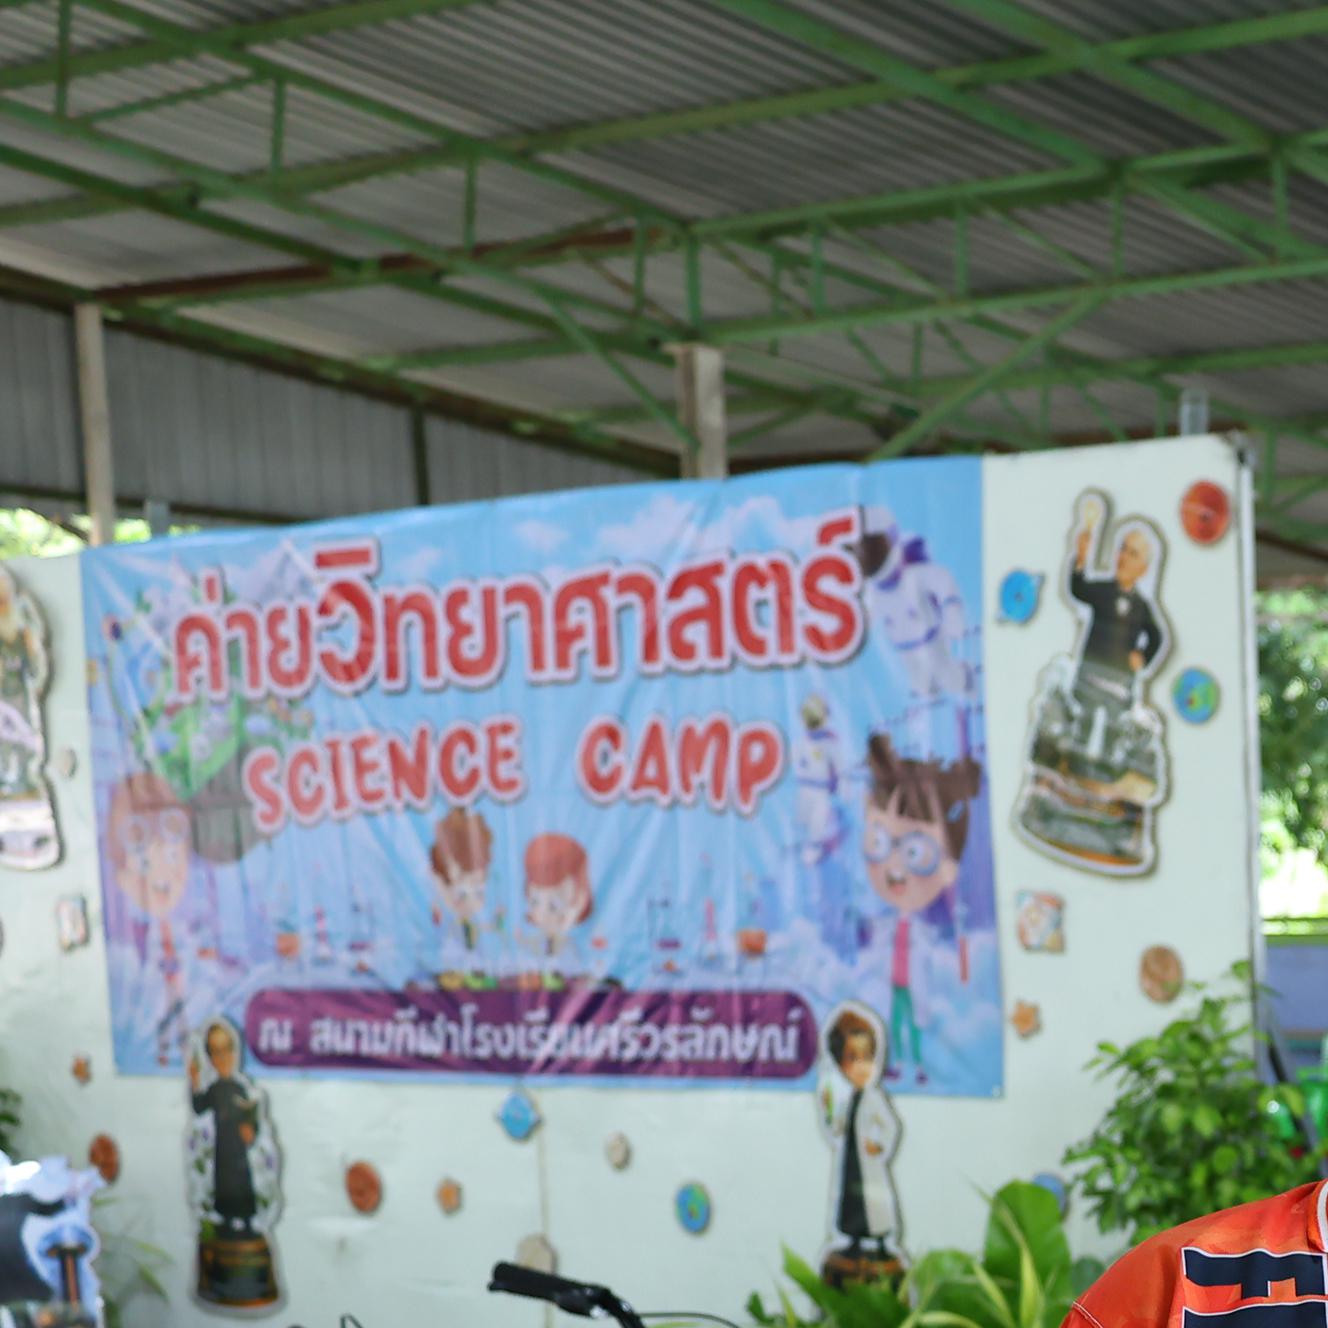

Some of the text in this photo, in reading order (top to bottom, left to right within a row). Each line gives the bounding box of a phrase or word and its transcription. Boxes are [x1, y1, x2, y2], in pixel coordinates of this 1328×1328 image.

[173, 512, 862, 696] ค่ายวิทยาศาสตร์
[245, 714, 784, 830] SCIENCE CAMP
[259, 1017, 293, 1053] ณ
